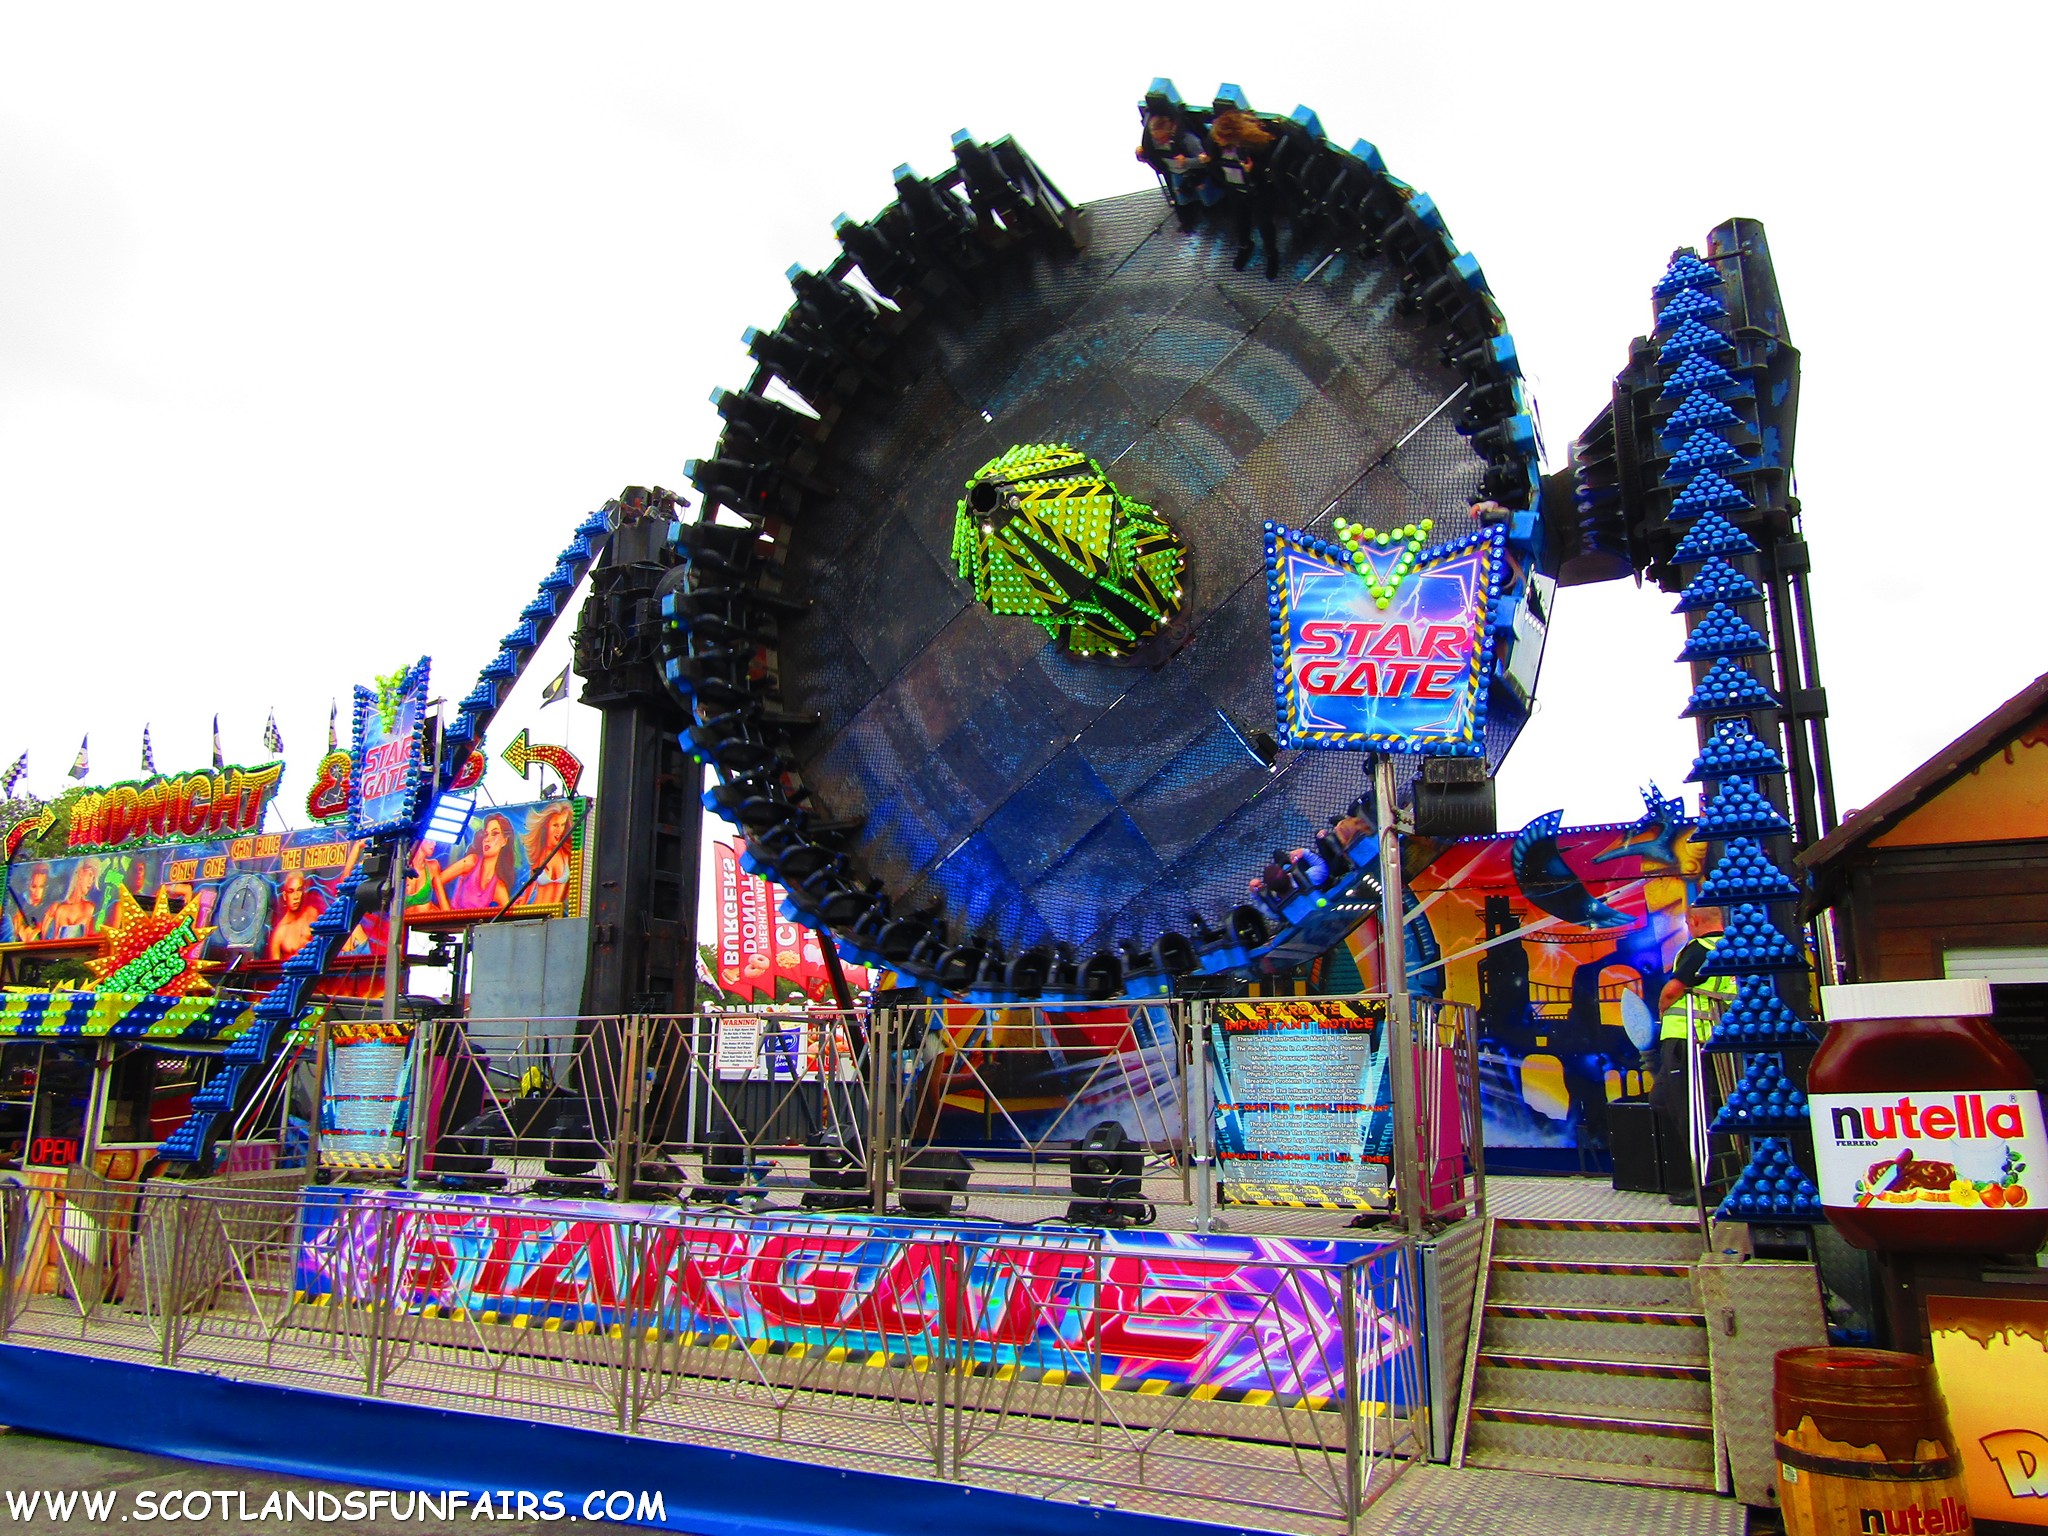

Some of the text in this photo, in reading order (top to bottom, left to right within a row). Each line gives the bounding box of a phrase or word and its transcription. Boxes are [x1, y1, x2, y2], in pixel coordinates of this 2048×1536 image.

[1294, 621, 1468, 660] STAR
[1298, 661, 1465, 699] GATE
[363, 736, 414, 775] STAR
[363, 764, 411, 801] GATE
[69, 764, 282, 847] MIDNIGHT
[231, 835, 282, 859] CAN RULE
[281, 843, 348, 871] THE NATION
[169, 857, 226, 881] ONLY ONE
[1256, 1004, 1340, 1016] STARGATE
[1831, 1094, 2024, 1139] nutella
[30, 1138, 78, 1165] OPEN
[373, 1211, 1253, 1361] STARGATE
